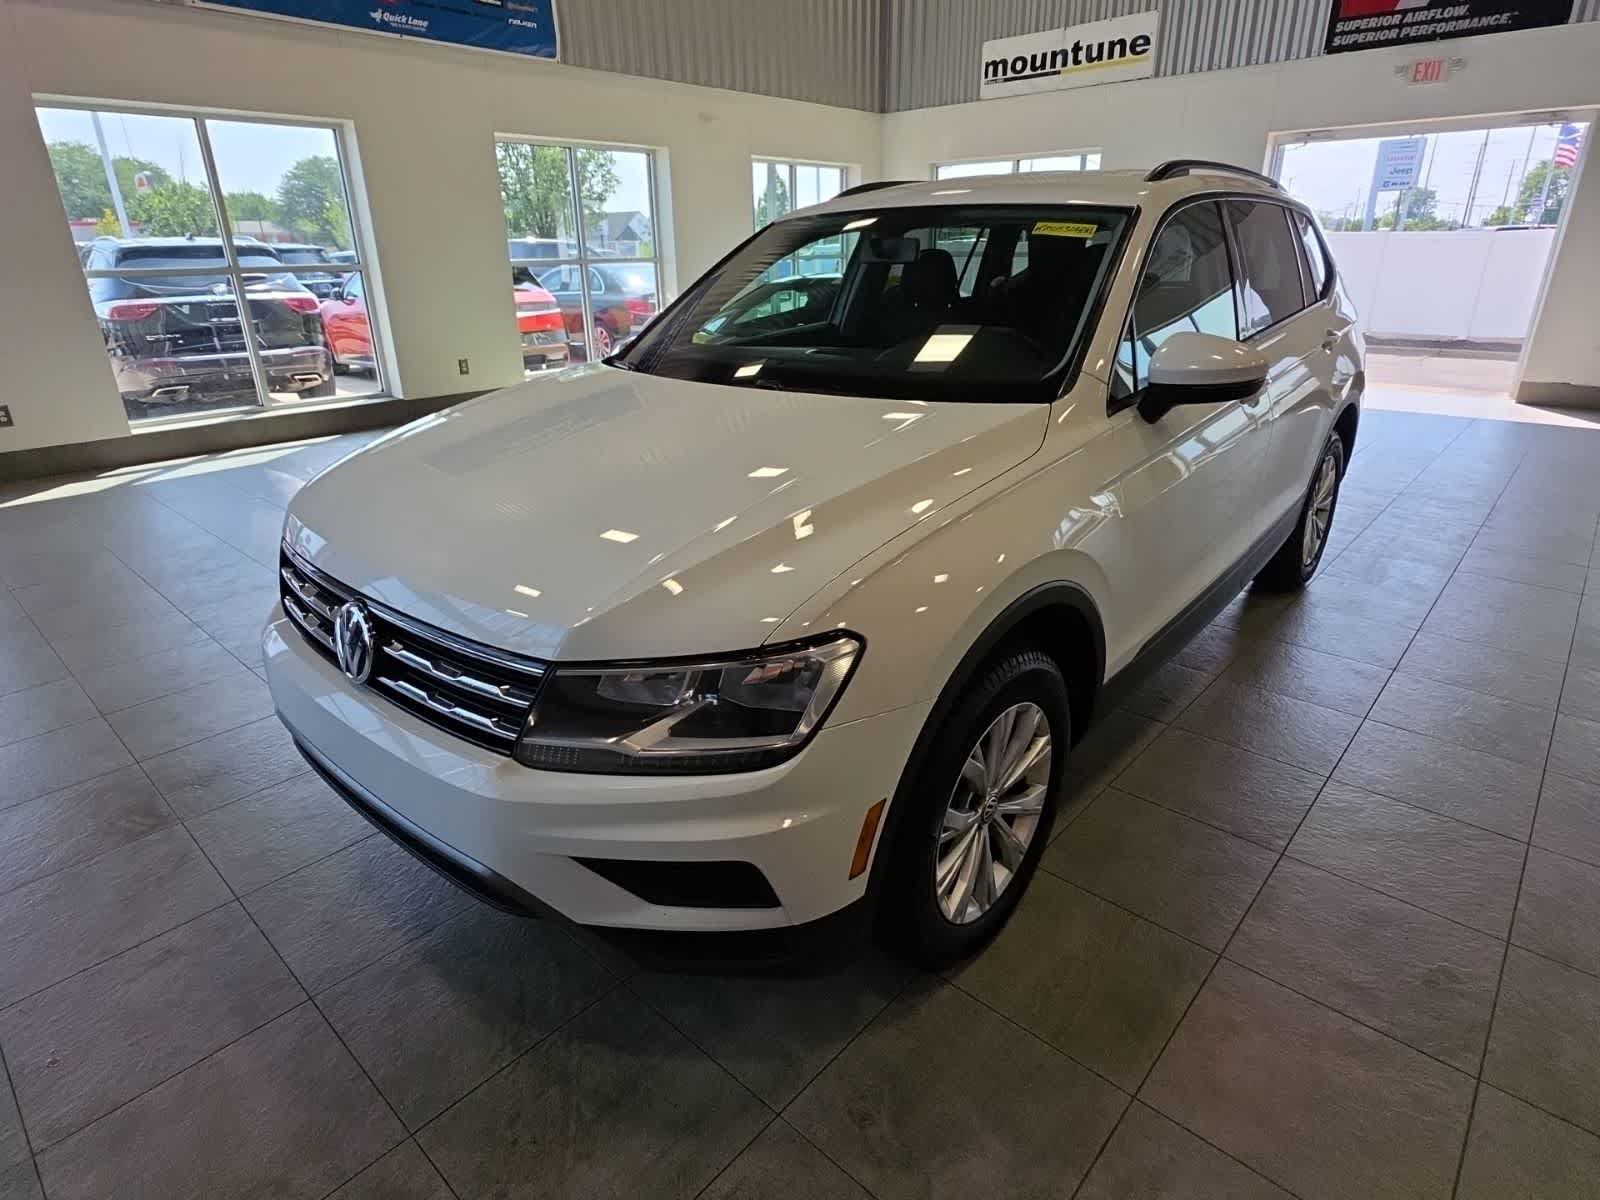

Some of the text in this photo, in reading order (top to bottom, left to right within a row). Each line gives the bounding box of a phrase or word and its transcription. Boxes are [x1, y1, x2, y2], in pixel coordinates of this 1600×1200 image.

[383, 12, 407, 24] Quick
[407, 16, 429, 28] Lane
[1335, 4, 1471, 33] SUPERIOR AIRFLOW.
[1331, 28, 1399, 47] SUPERIOR
[984, 34, 1151, 79] mountune
[1412, 60, 1443, 83] EXIT
